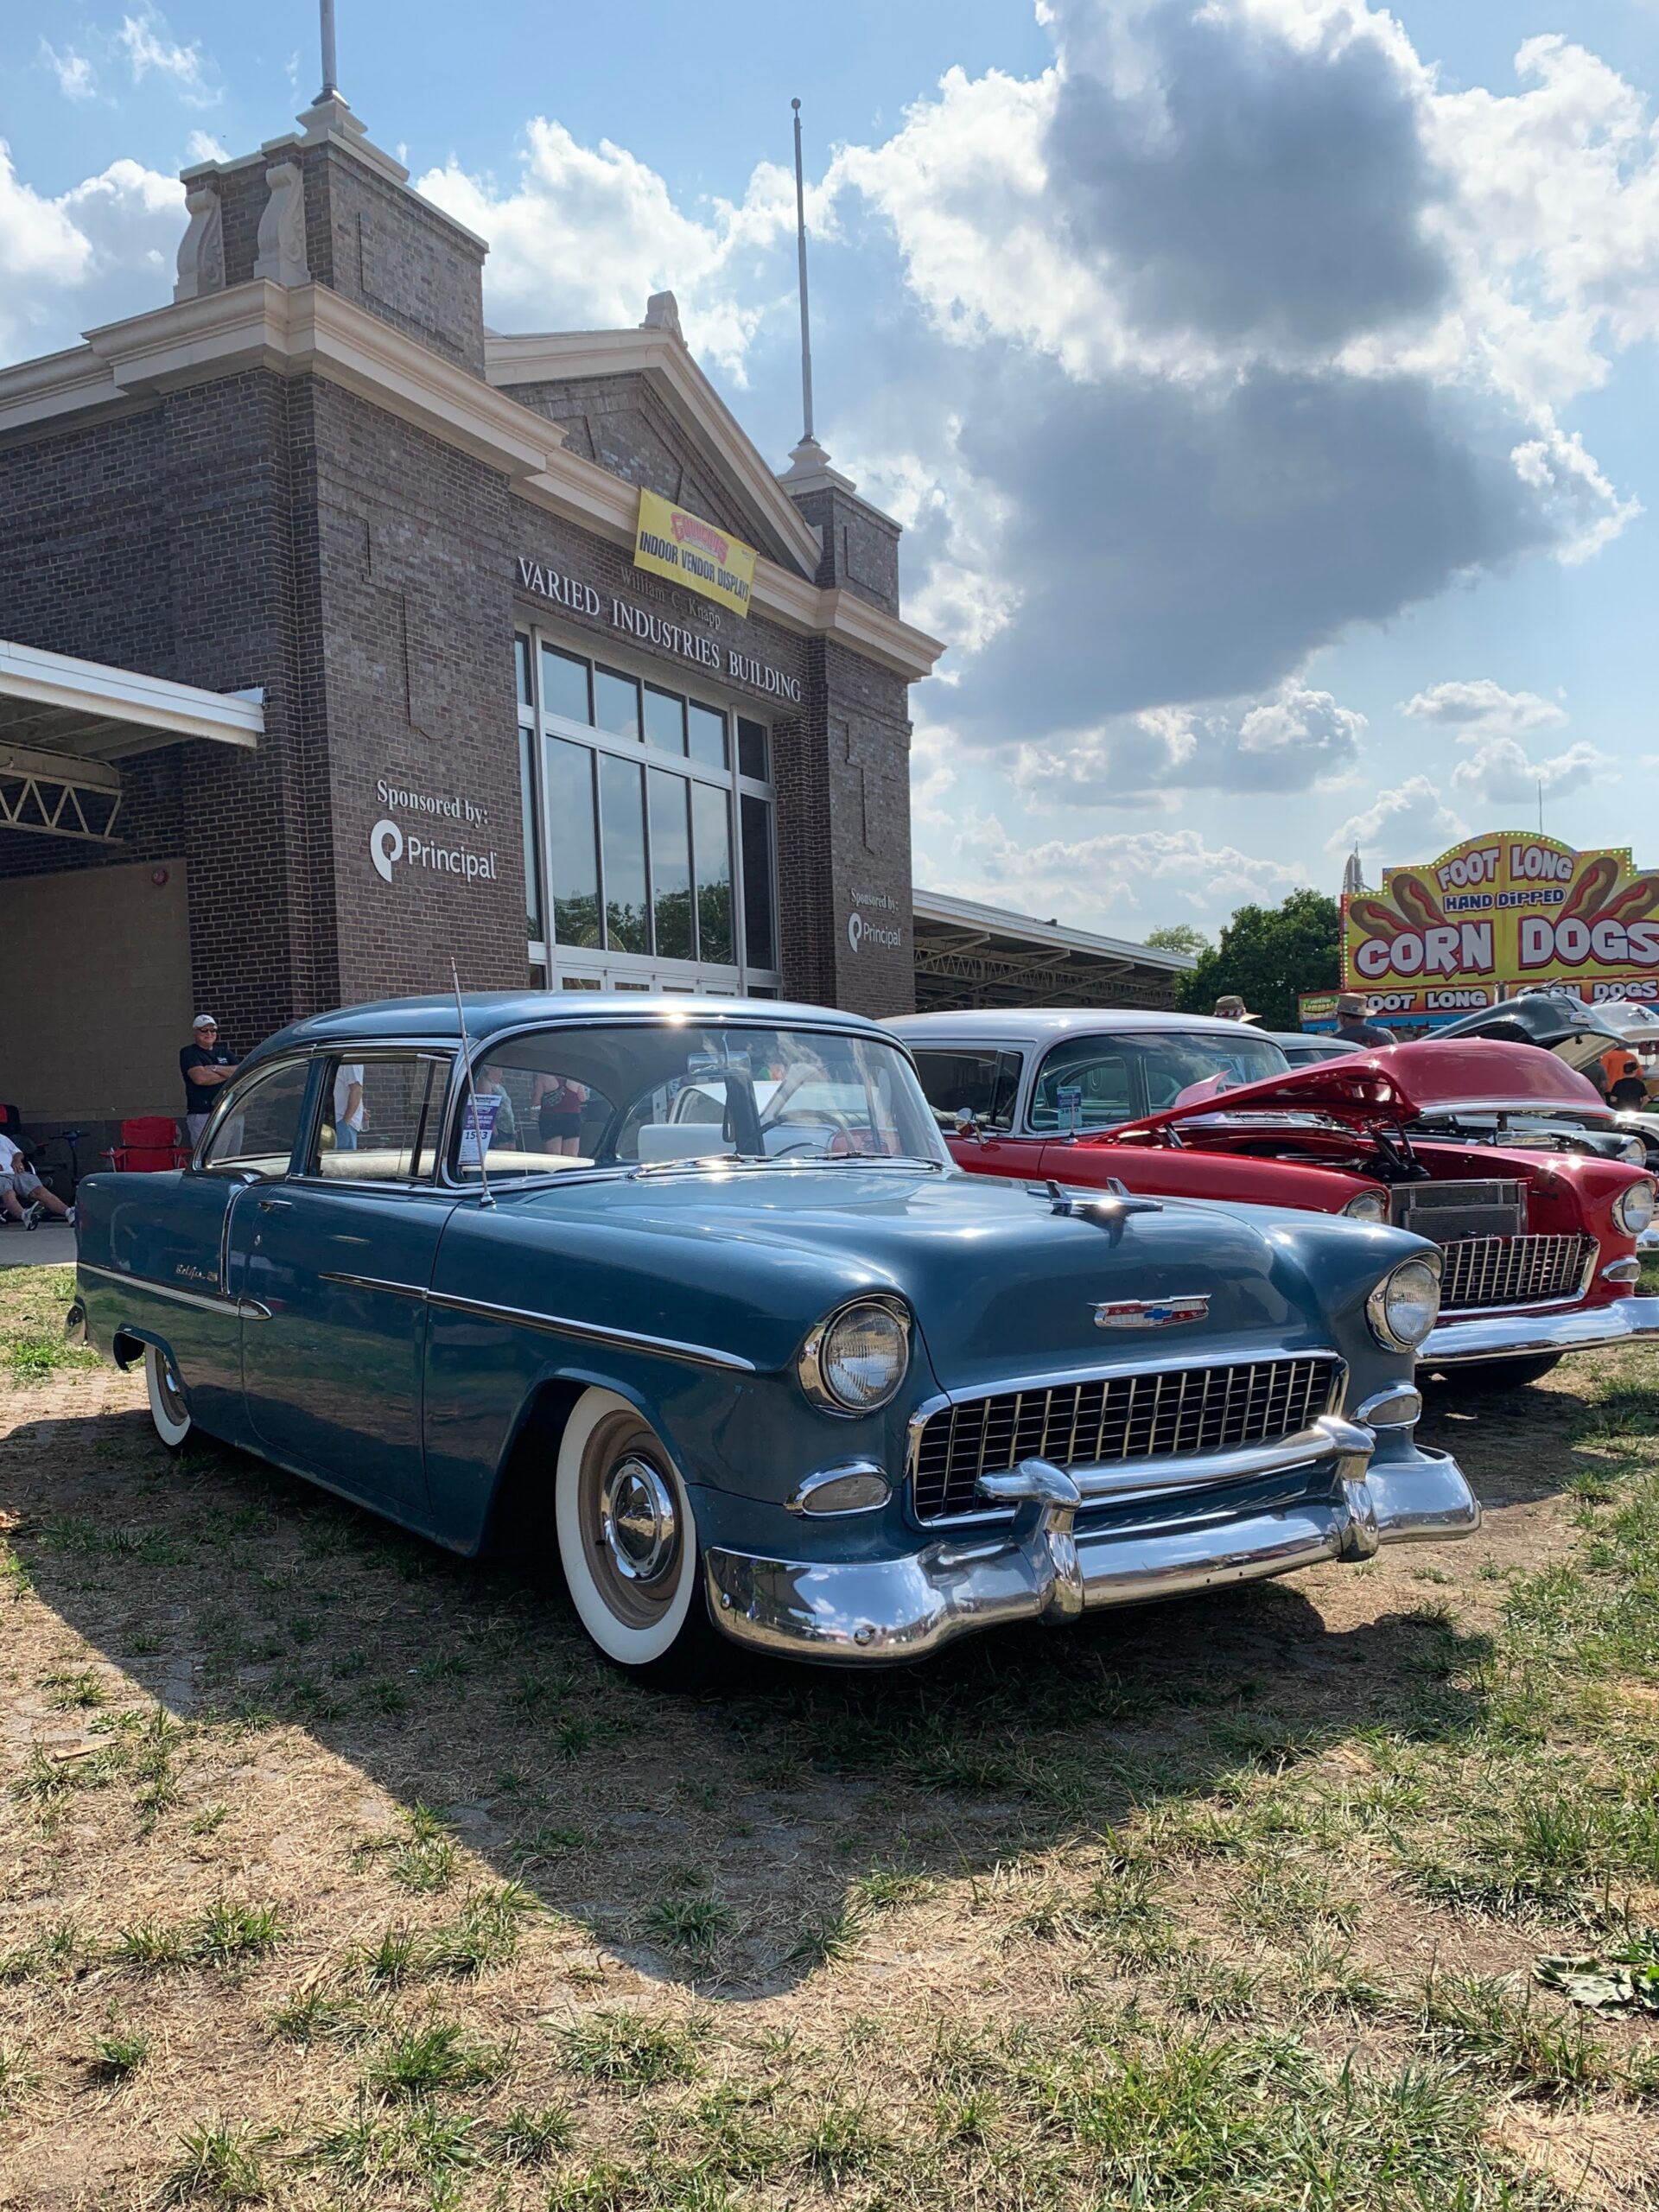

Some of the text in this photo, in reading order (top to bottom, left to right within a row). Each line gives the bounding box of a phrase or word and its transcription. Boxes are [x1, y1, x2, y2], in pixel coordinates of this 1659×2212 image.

[639, 531, 678, 565] INDOOR
[681, 549, 715, 582] VENDOR
[717, 568, 750, 602] DISPLAYS
[621, 565, 665, 602] William
[689, 598, 721, 630] Knapp
[518, 556, 802, 702] VARIED INDUSTRIES BUILDING
[376, 779, 489, 829] Sponsored by:
[408, 836, 497, 882] Principal
[1437, 844, 1574, 891] FOOT LONG
[850, 887, 899, 914] Sponsored by:
[1444, 893, 1493, 913] HAND
[864, 922, 901, 950] Principal
[1355, 916, 1659, 979] CORN DOGS
[1365, 990, 1488, 1012] OOT LONG
[1593, 980, 1659, 999] DOGS
[467, 1131, 488, 1140] 153
